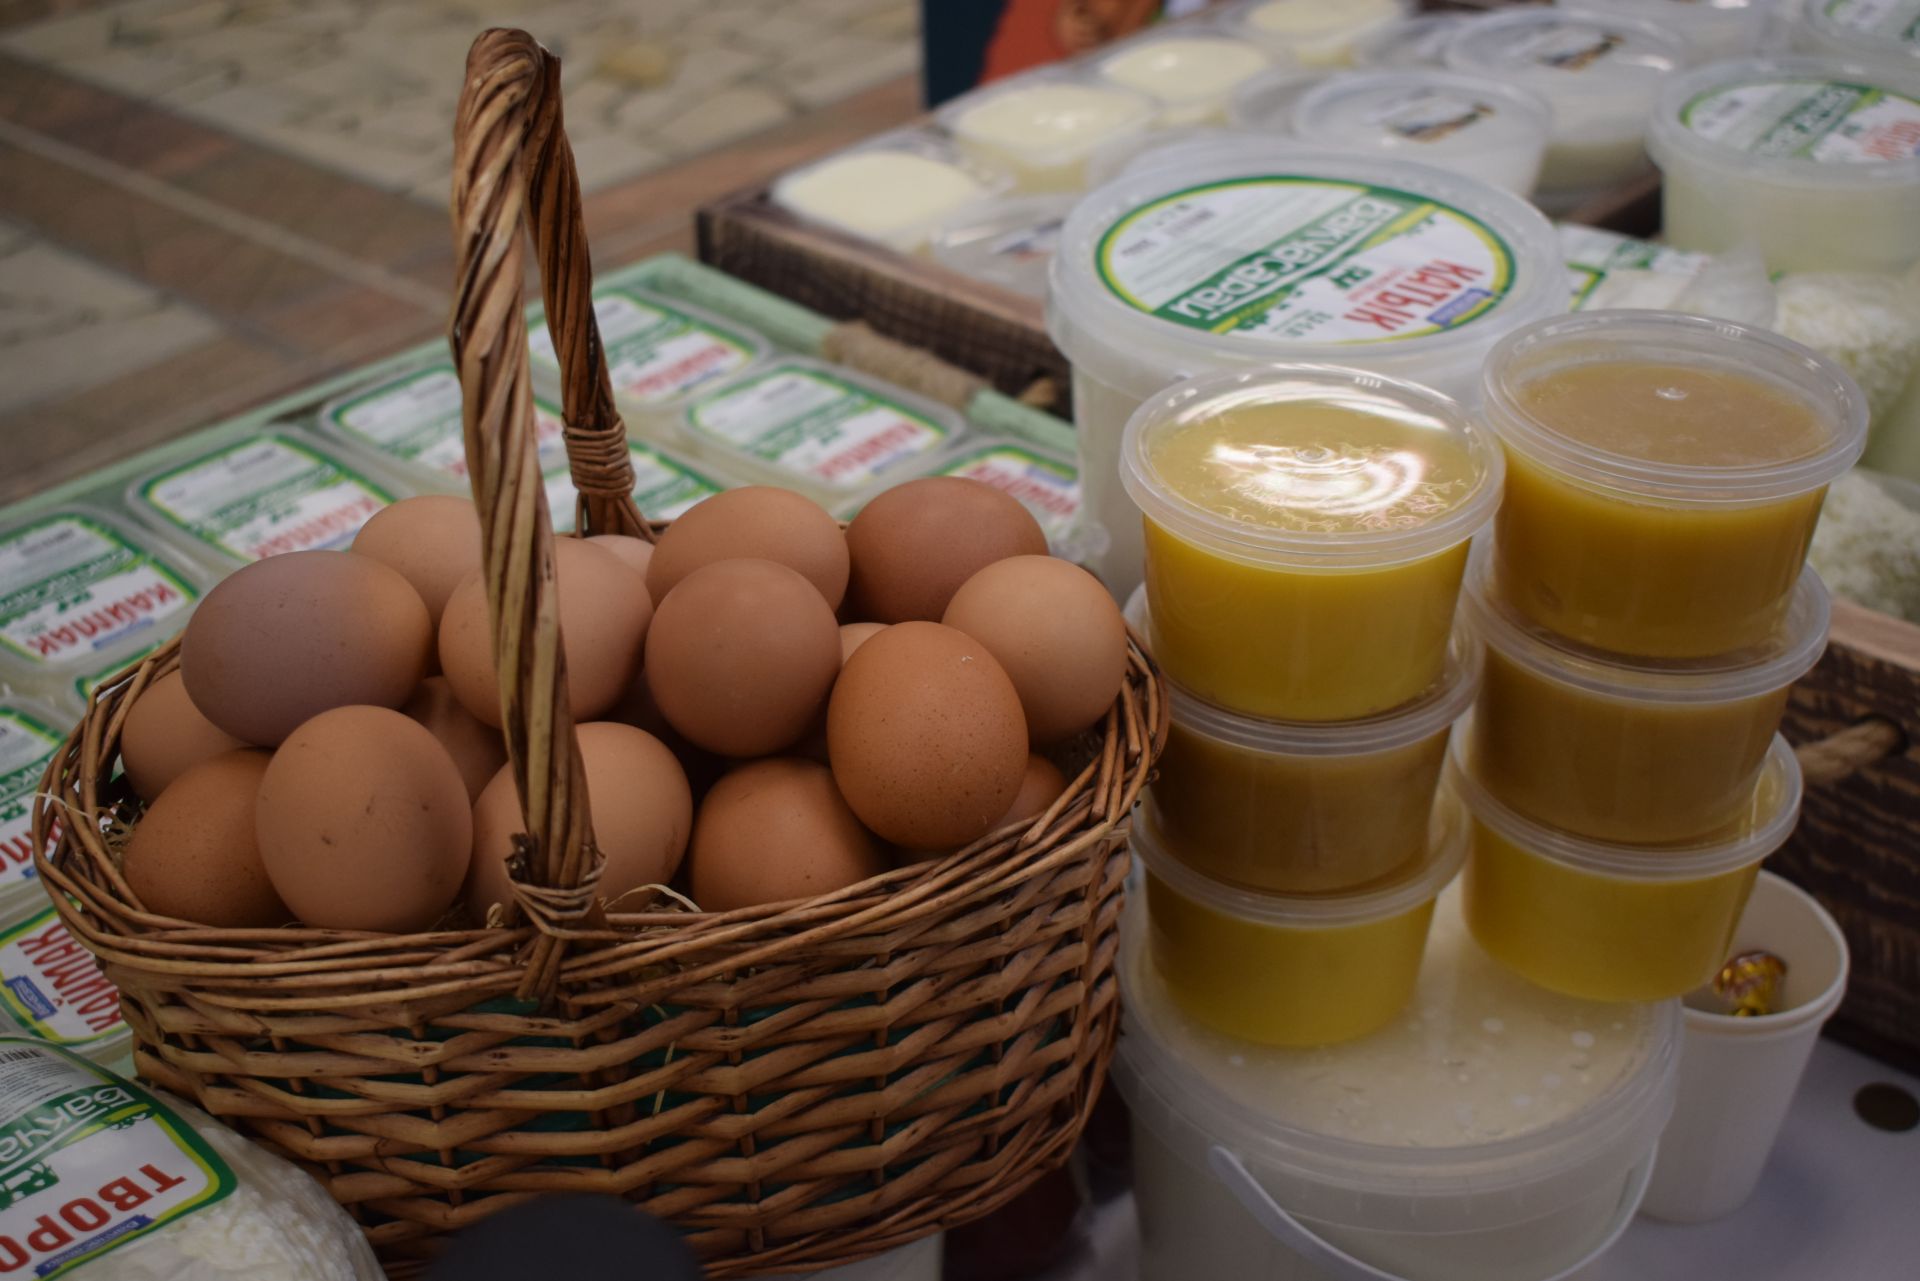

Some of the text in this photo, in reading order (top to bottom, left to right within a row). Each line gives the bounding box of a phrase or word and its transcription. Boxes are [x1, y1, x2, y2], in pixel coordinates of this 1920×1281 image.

[1168, 196, 1402, 320] Бакчасарай
[1342, 260, 1485, 331] КАТЫК
[17, 923, 122, 1032] КАЙМАК
